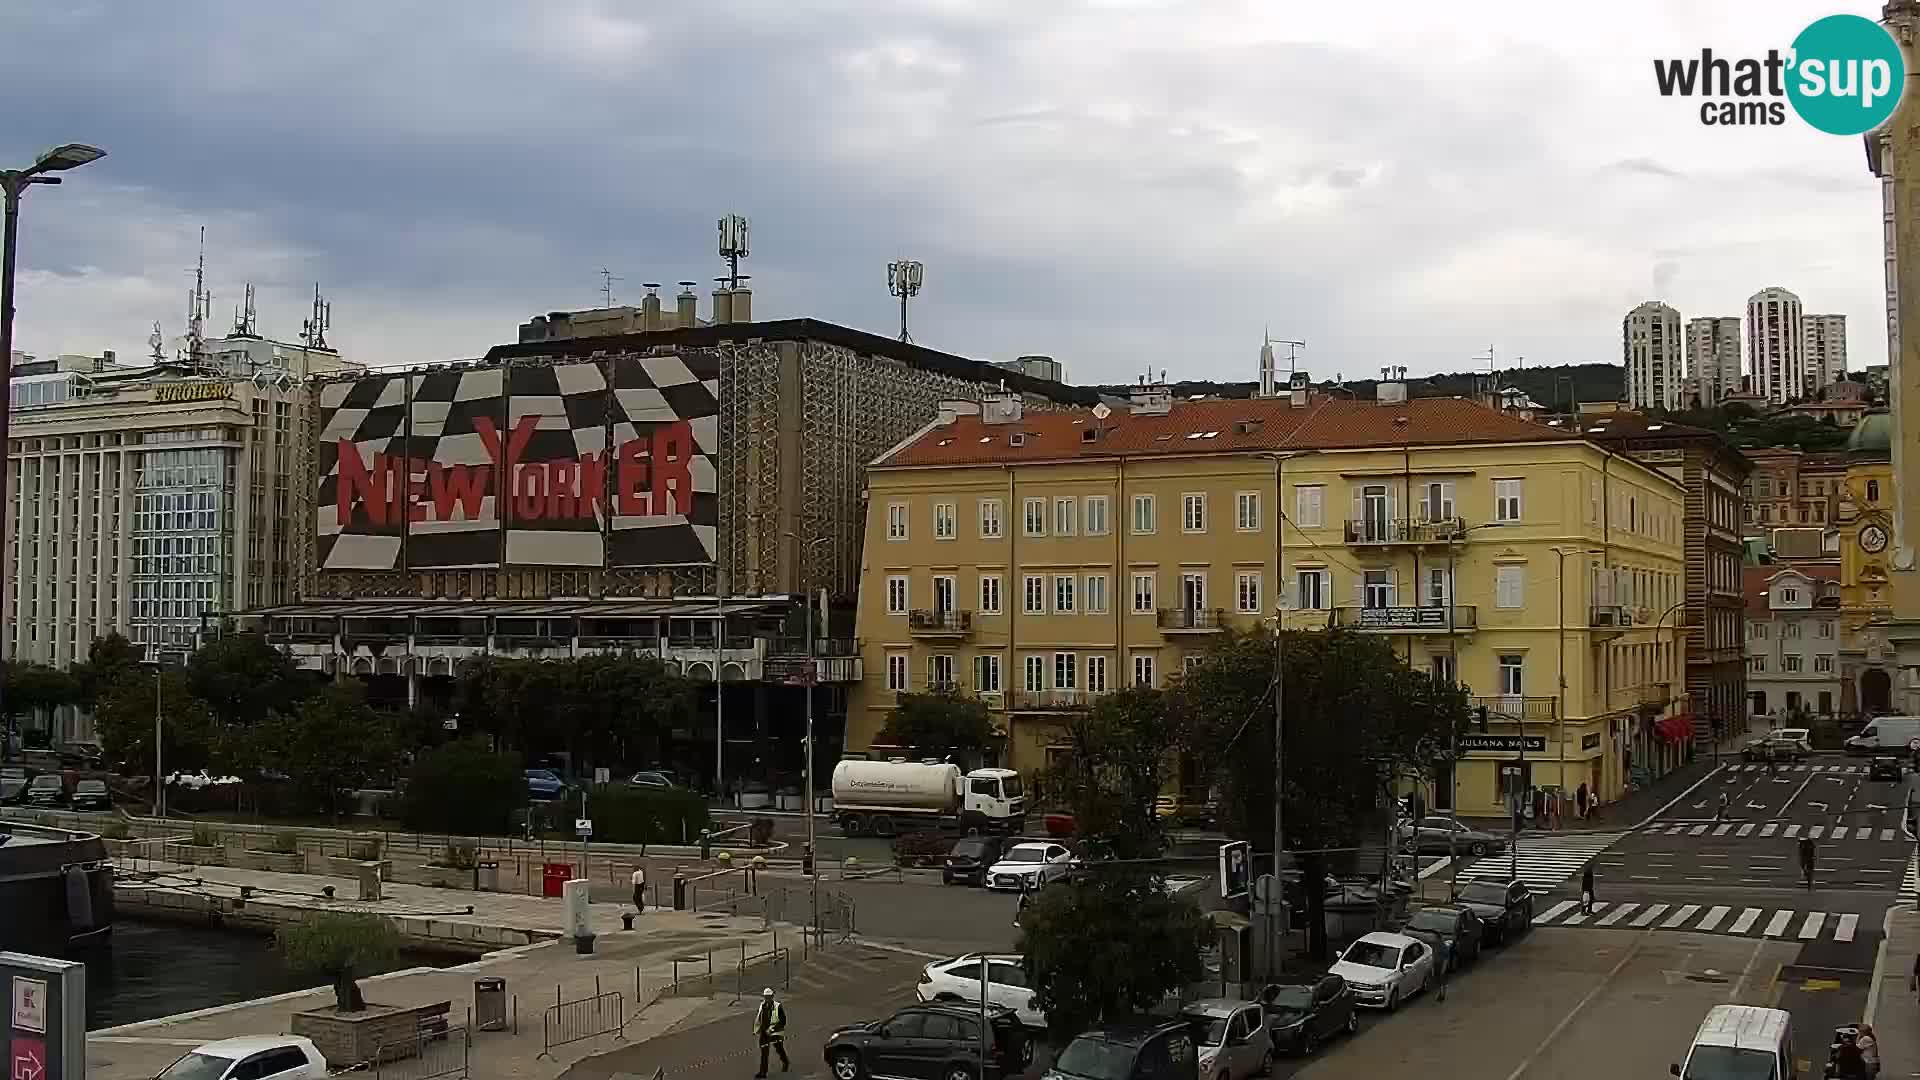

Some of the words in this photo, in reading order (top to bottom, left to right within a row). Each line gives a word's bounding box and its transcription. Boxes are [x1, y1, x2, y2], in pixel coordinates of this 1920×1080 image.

[336, 436, 492, 527] NEW
[472, 413, 694, 521] YORKER
[1459, 738, 1505, 748] JULIANA
[1508, 739, 1541, 748] NAILS
